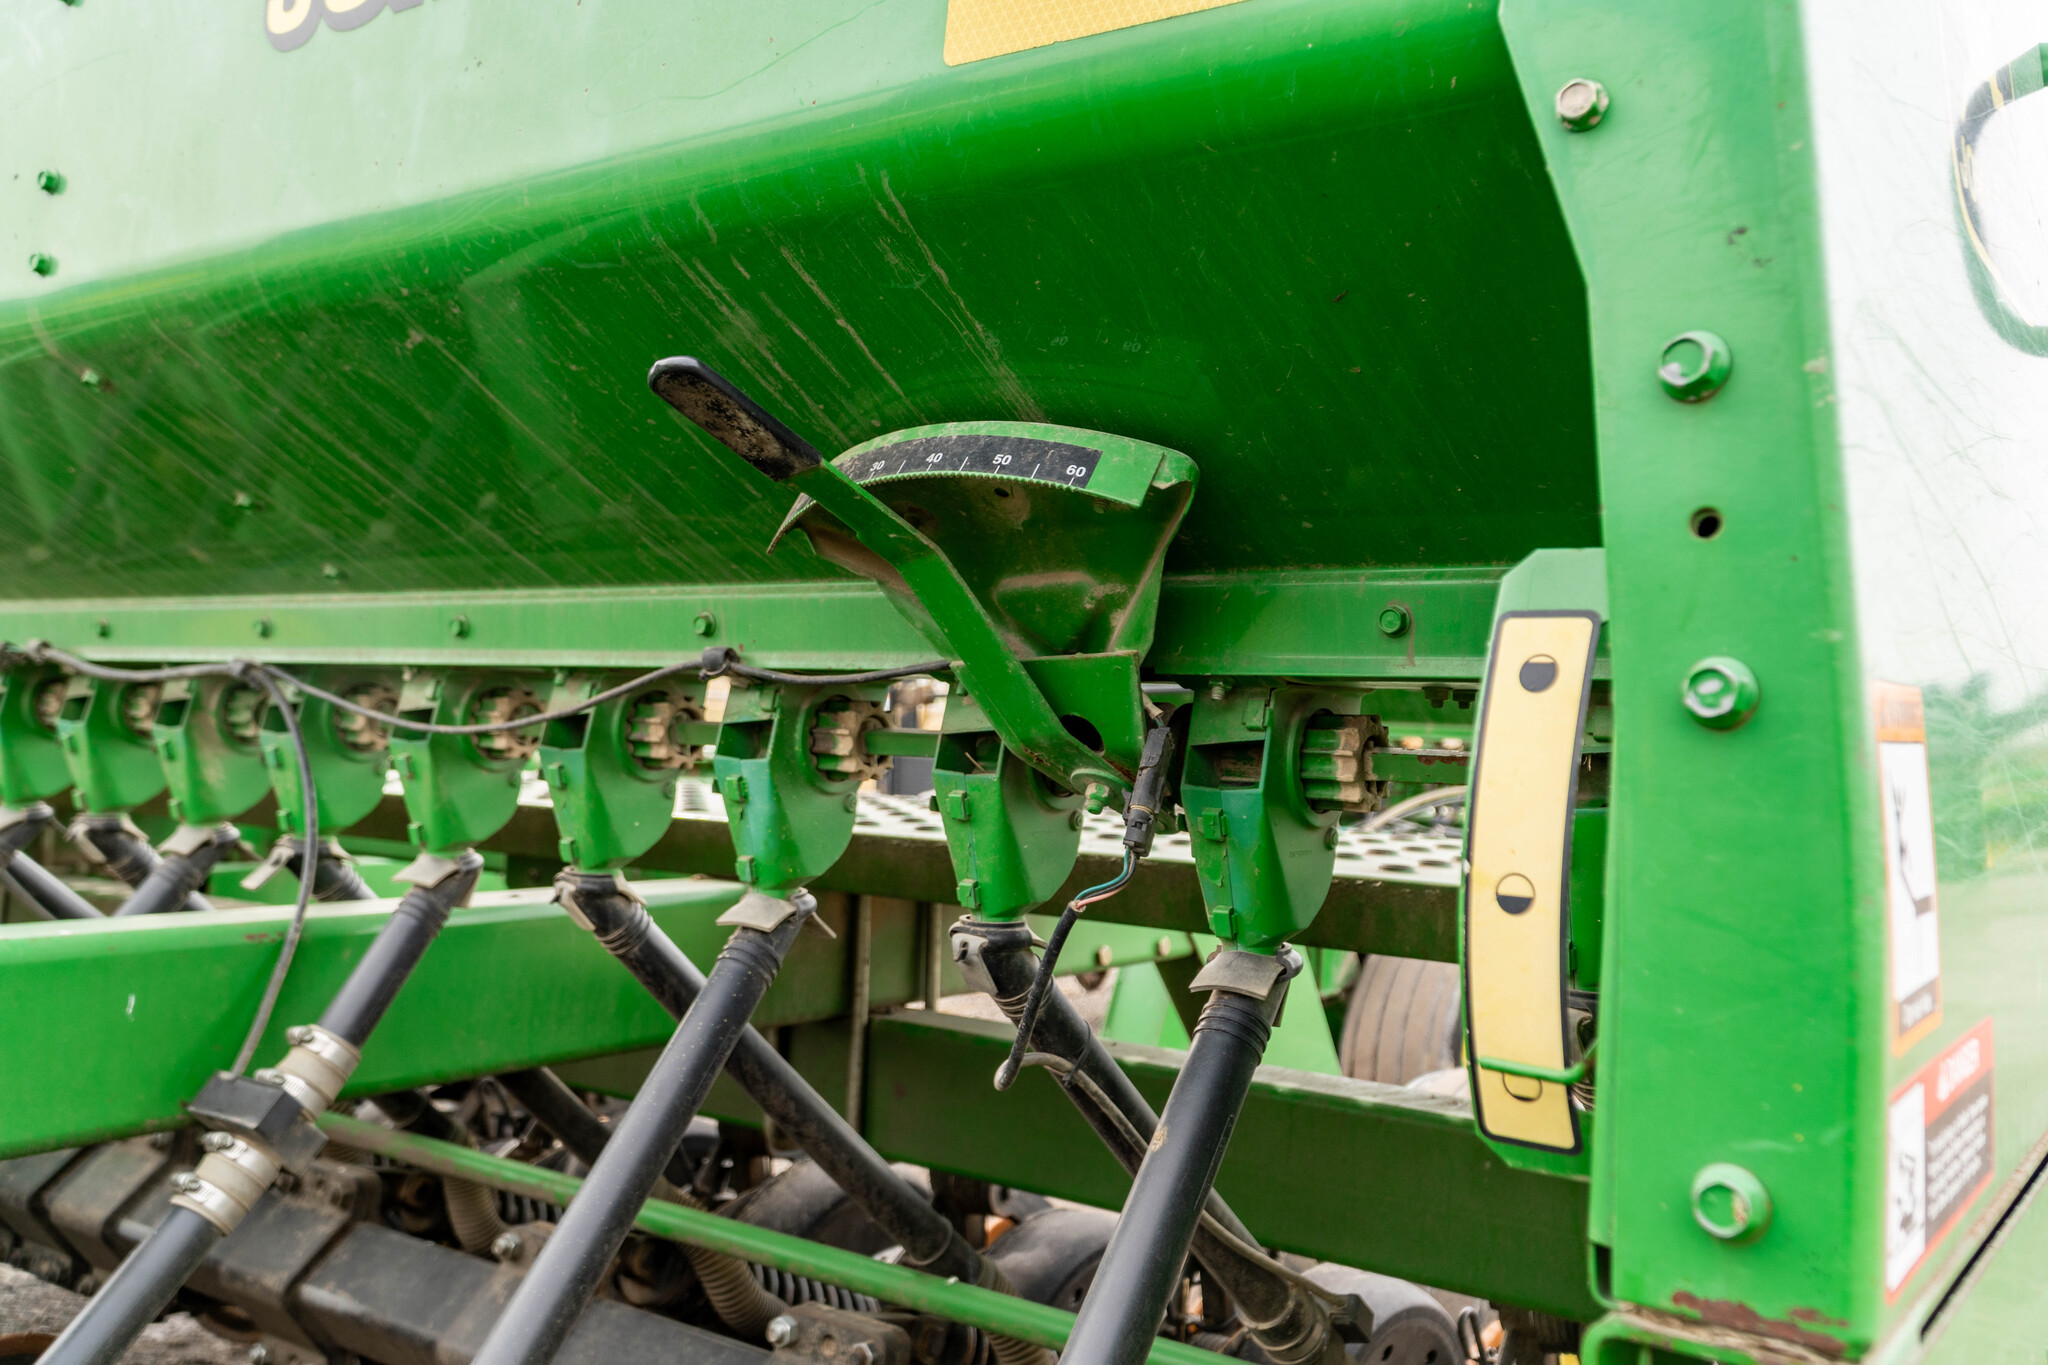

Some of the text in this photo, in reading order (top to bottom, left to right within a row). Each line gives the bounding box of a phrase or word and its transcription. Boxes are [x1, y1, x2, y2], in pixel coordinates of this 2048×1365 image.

[869, 452, 1087, 477] 30 40 50 60
